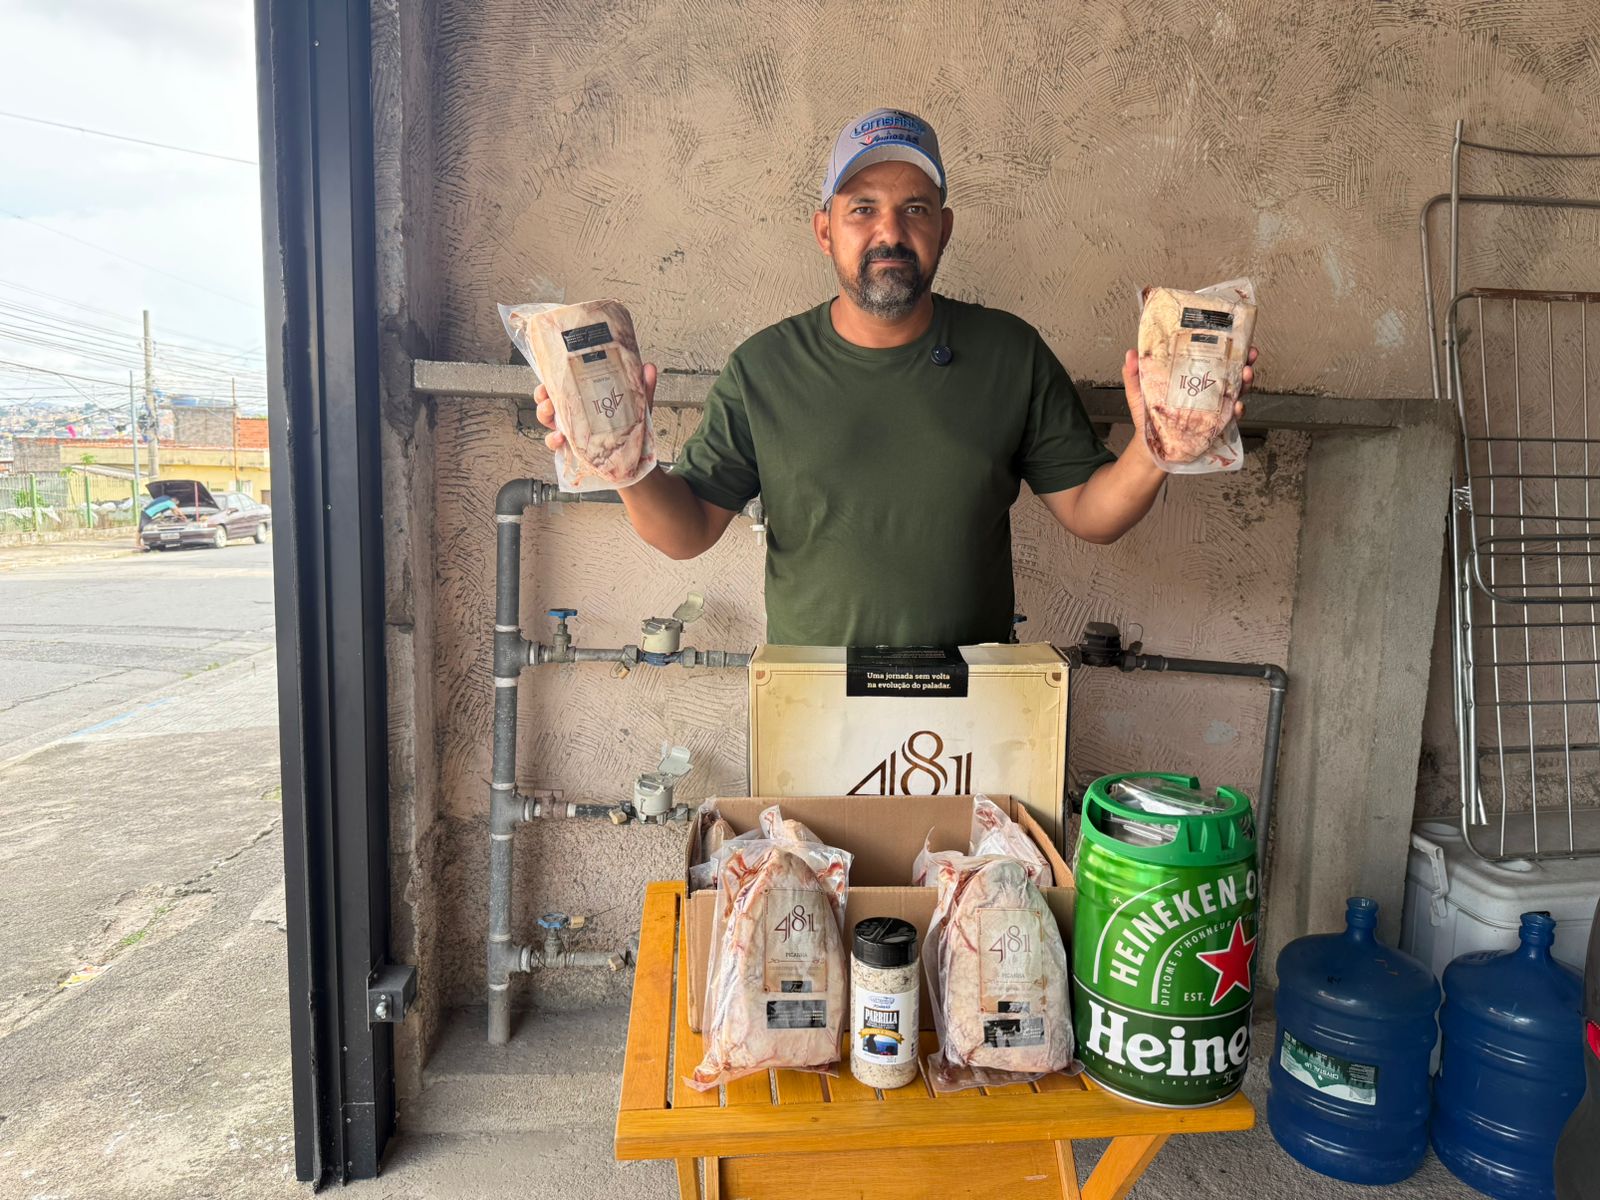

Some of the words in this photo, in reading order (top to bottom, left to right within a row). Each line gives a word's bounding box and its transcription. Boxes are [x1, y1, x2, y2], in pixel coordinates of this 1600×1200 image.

[867, 672, 884, 680] Uma
[885, 672, 914, 681] jornada
[932, 672, 950, 680] volta
[878, 681, 910, 690] evolução
[912, 681, 921, 689] do
[922, 682, 951, 690] paladar.
[846, 730, 972, 796] 481
[1110, 875, 1238, 988] HEINEKEN
[1161, 960, 1177, 1006] DIPLOME
[1174, 919, 1232, 957] D'HONNEUR
[1184, 992, 1206, 1002] EST.
[865, 1008, 898, 1024] PARRILLA
[1313, 1065, 1339, 1080] CRYSTAL
